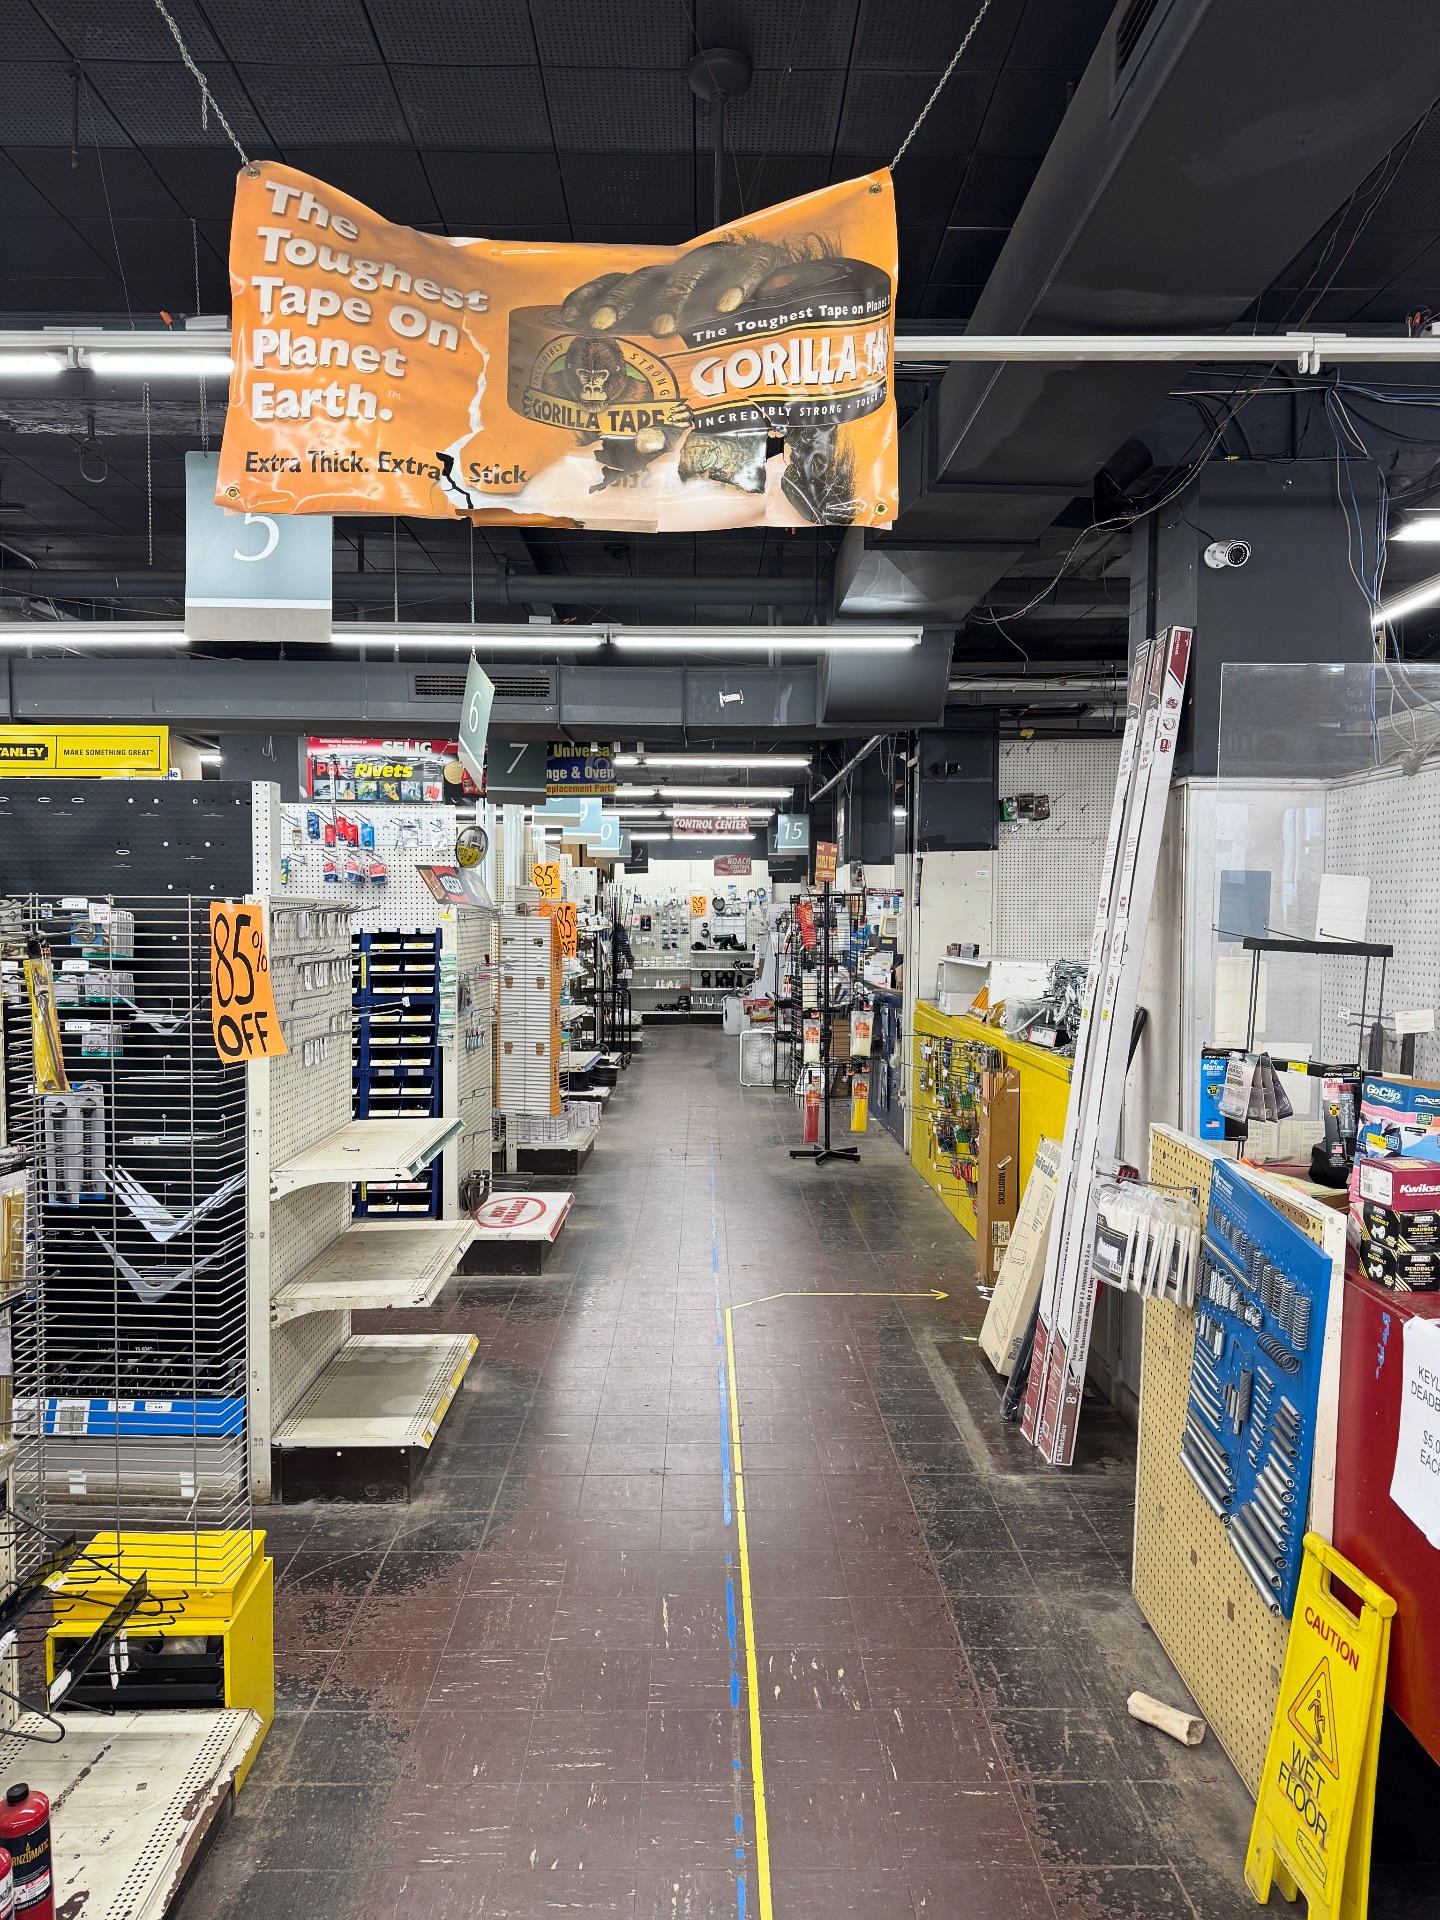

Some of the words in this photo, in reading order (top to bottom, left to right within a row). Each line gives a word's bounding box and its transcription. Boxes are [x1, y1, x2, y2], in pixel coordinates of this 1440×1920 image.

[265, 180, 358, 240] The
[257, 227, 488, 313] Toughest
[251, 276, 372, 326] Tape
[388, 305, 459, 350] On
[693, 326, 728, 343] The
[734, 308, 814, 330] Toughest
[818, 304, 849, 319] Tape
[851, 304, 864, 315] on
[251, 329, 407, 377] Planet
[533, 342, 564, 386] INCREDIBLY
[690, 335, 858, 398] GORILLA
[630, 352, 670, 396] STRONG
[251, 381, 393, 421] Earth.
[532, 398, 600, 430] GORILLA
[698, 406, 792, 429] INCREDIBLY
[799, 404, 842, 417] STRONG
[245, 451, 301, 474] Extra
[307, 450, 369, 473] Thick.
[377, 451, 441, 481] Extra
[468, 462, 528, 486] Stick
[233, 512, 280, 562] 5
[469, 690, 481, 733] 6
[506, 743, 529, 774] 7
[553, 743, 615, 758] Universal
[354, 763, 413, 778] Rivets
[546, 766, 568, 781] nge
[571, 766, 581, 779] &
[585, 766, 615, 779] Oven
[546, 784, 594, 794] eplacement
[594, 784, 616, 793] Parts
[600, 823, 613, 840] 0
[673, 818, 713, 830] CONTROL
[714, 819, 748, 830] CENTER
[784, 822, 803, 840] 15
[618, 835, 624, 849] 1
[634, 848, 643, 861] 2
[533, 865, 561, 887] 85%
[727, 857, 751, 865] ROACH
[539, 887, 558, 898] OFF
[213, 912, 268, 1008] 85%
[217, 1011, 268, 1056] OFF
[998, 1171, 1006, 1205] YARDSTICKS
[1418, 1365, 1440, 1392] KEYL
[1411, 1380, 1440, 1412] DEADB
[1058, 1424, 1068, 1451] Metalux
[1304, 1606, 1360, 1671] CAUTION
[1291, 1741, 1326, 1801] WET
[1277, 1760, 1327, 1849] FLOOR
[12, 1839, 49, 1866] RNZOMATIC
